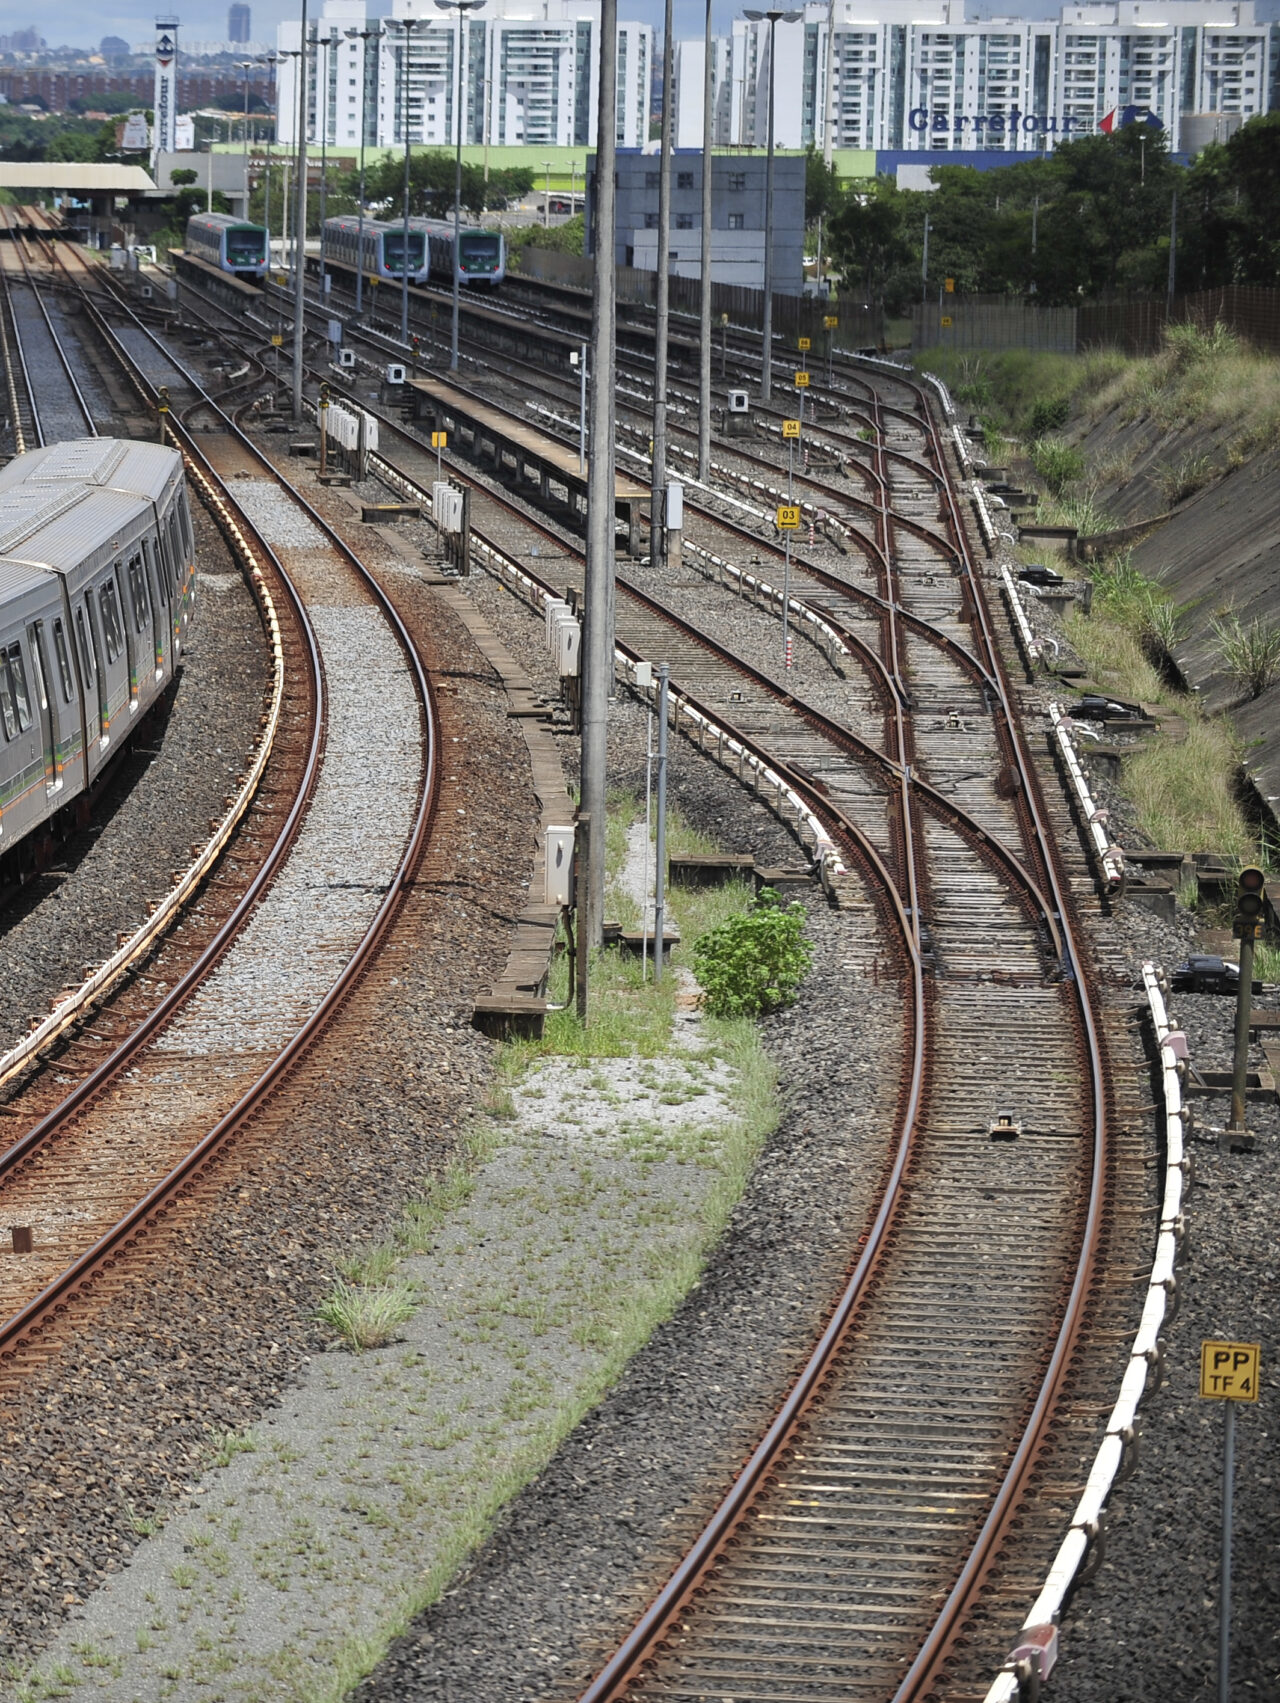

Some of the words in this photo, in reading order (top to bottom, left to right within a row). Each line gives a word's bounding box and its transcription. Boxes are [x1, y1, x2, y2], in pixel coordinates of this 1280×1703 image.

[908, 108, 1077, 133] Carrefour
[787, 423, 797, 431] 04
[782, 510, 795, 520] 03
[1213, 1351, 1250, 1371] PP
[1209, 1375, 1234, 1392] TF
[1240, 1377, 1251, 1393] 4
